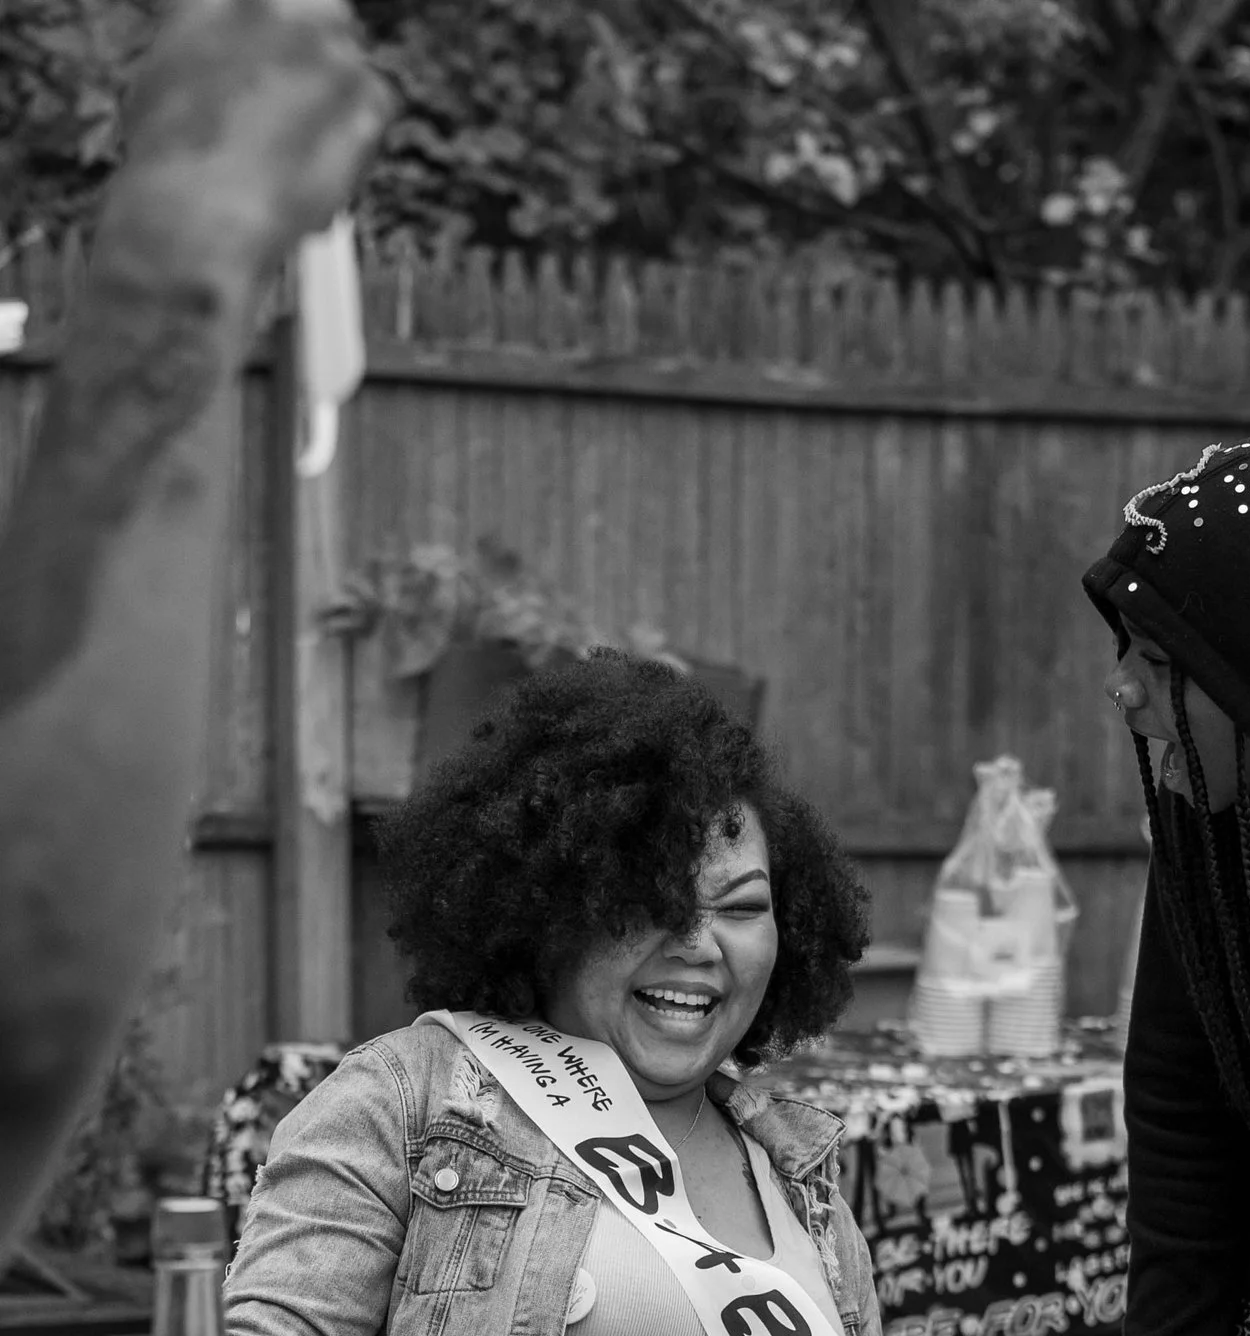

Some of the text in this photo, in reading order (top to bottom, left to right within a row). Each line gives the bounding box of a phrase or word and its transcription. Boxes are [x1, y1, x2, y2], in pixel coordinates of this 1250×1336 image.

[468, 1022, 571, 1107] I'M HAVING A
[523, 1026, 613, 1111] ONE WHERE
[932, 1255, 989, 1294] YOU
